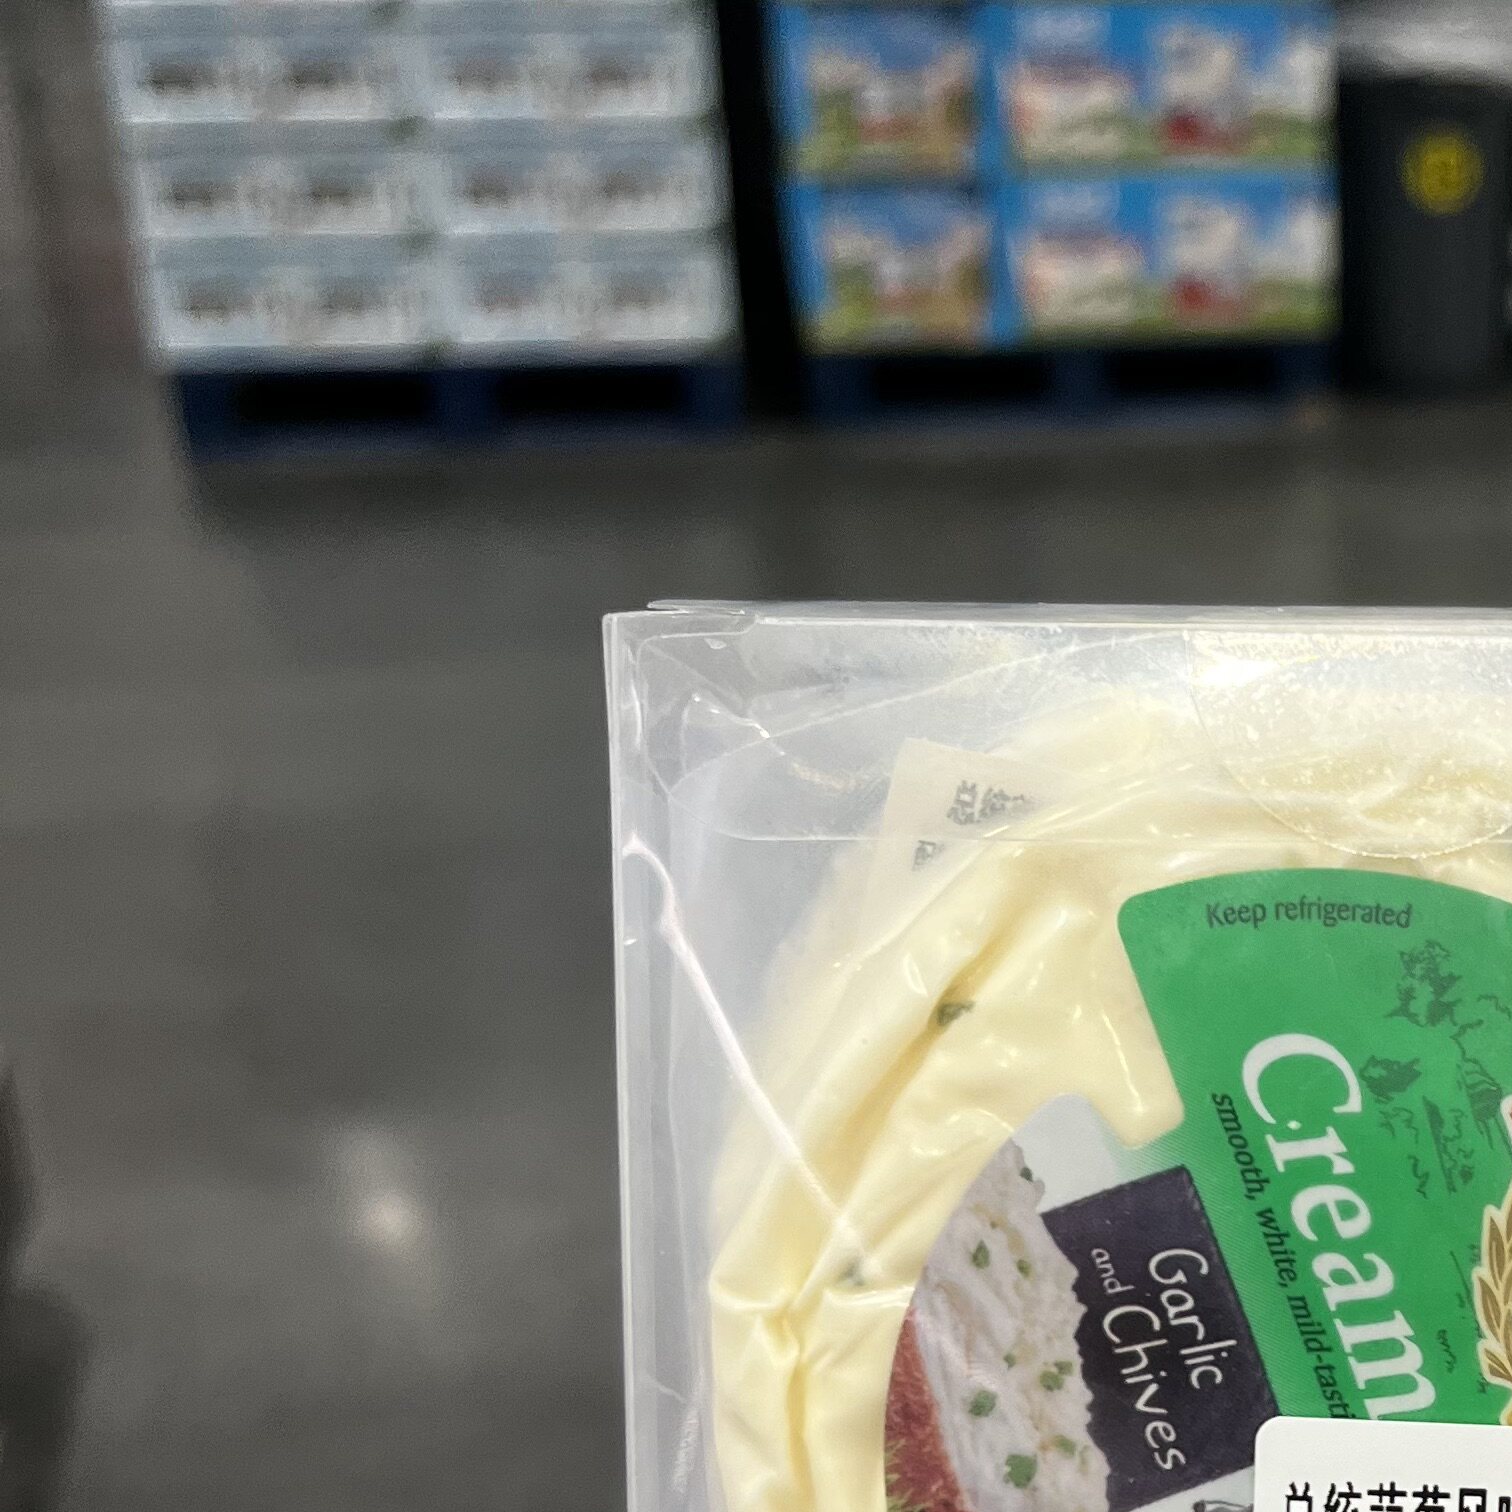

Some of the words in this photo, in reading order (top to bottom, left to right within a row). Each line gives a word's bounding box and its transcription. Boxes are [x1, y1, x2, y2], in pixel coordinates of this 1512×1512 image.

[1206, 901, 1267, 930] Keep
[1275, 895, 1413, 929] refrigerated
[1211, 1092, 1270, 1200] smooth,
[1256, 1207, 1298, 1288] white,
[1242, 1033, 1437, 1421] Cream
[1091, 1247, 1135, 1294] and
[1149, 1248, 1238, 1389] Garlic
[1103, 1304, 1187, 1471] Chives
